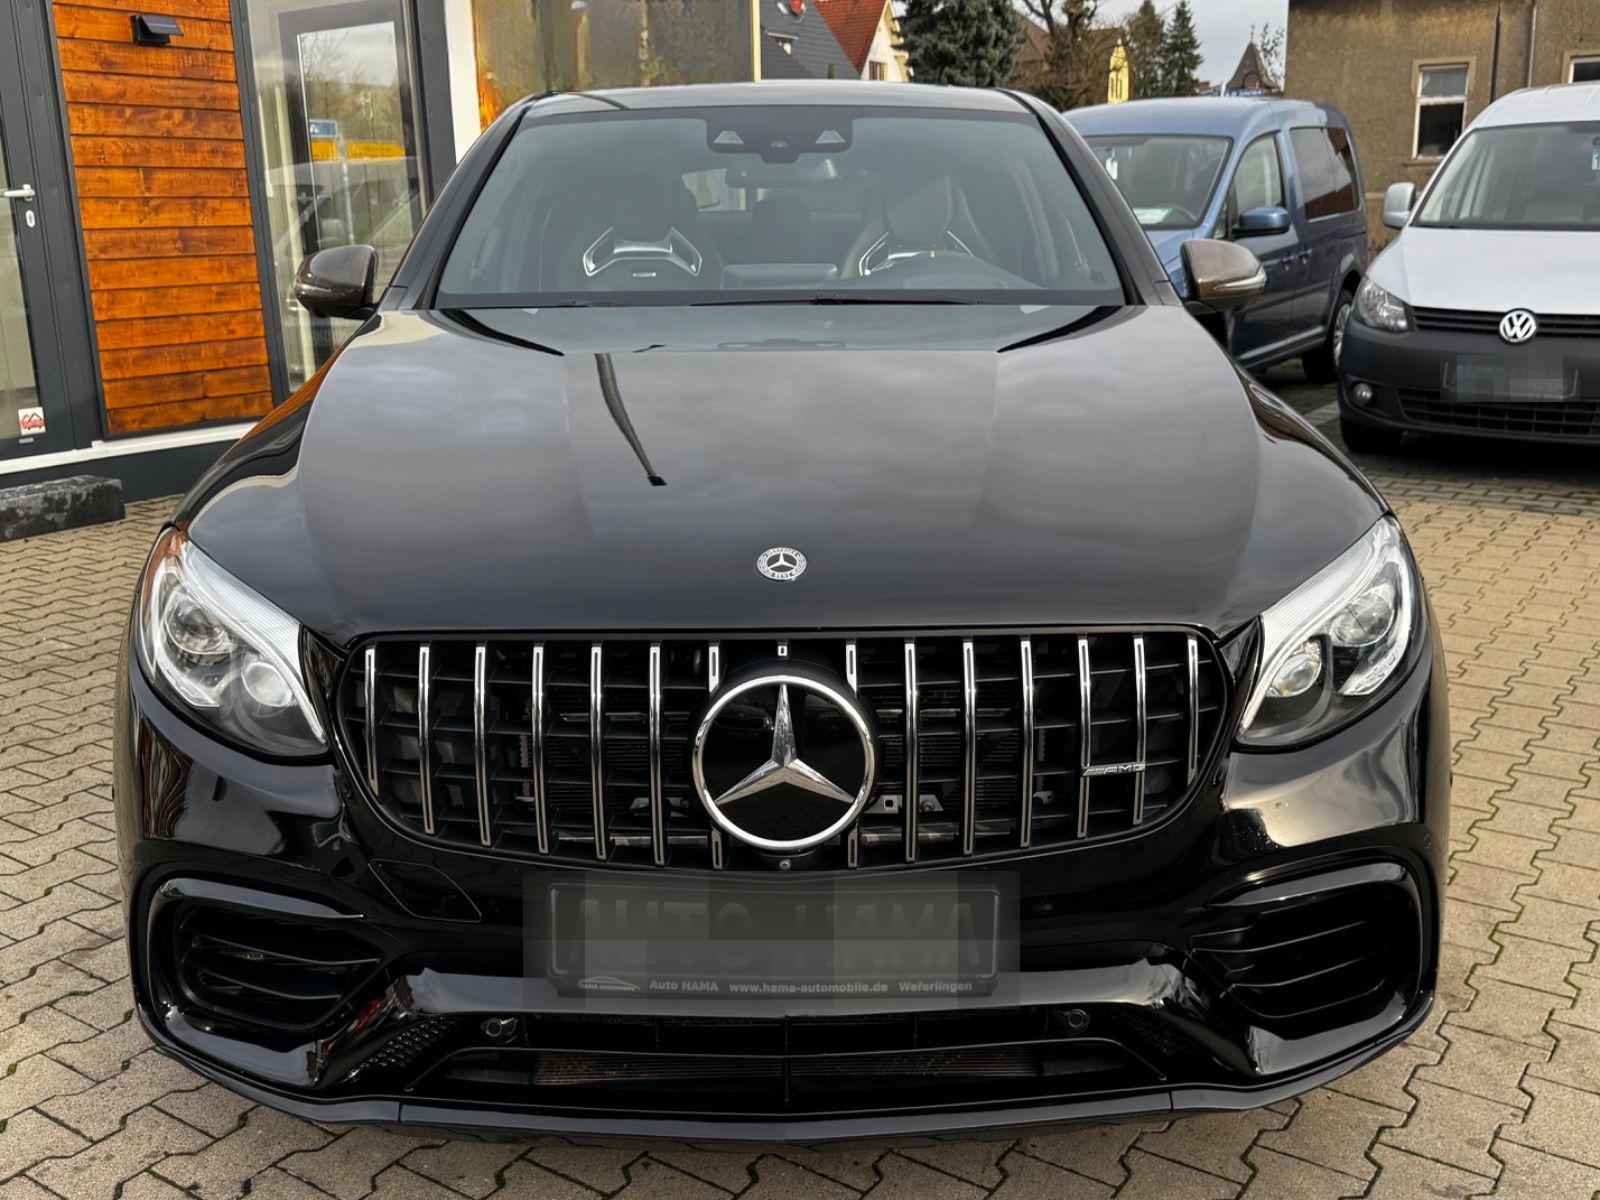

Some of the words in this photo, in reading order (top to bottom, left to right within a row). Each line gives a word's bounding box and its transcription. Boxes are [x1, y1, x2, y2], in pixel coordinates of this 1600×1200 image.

[1500, 310, 1536, 342] VW
[569, 899, 754, 968] AUTO
[795, 902, 980, 968] HAMA
[649, 979, 679, 990] Auto
[682, 981, 719, 992] HAMA
[729, 982, 888, 993] www.hama-automobile.de
[899, 981, 972, 994] Weferlingen
